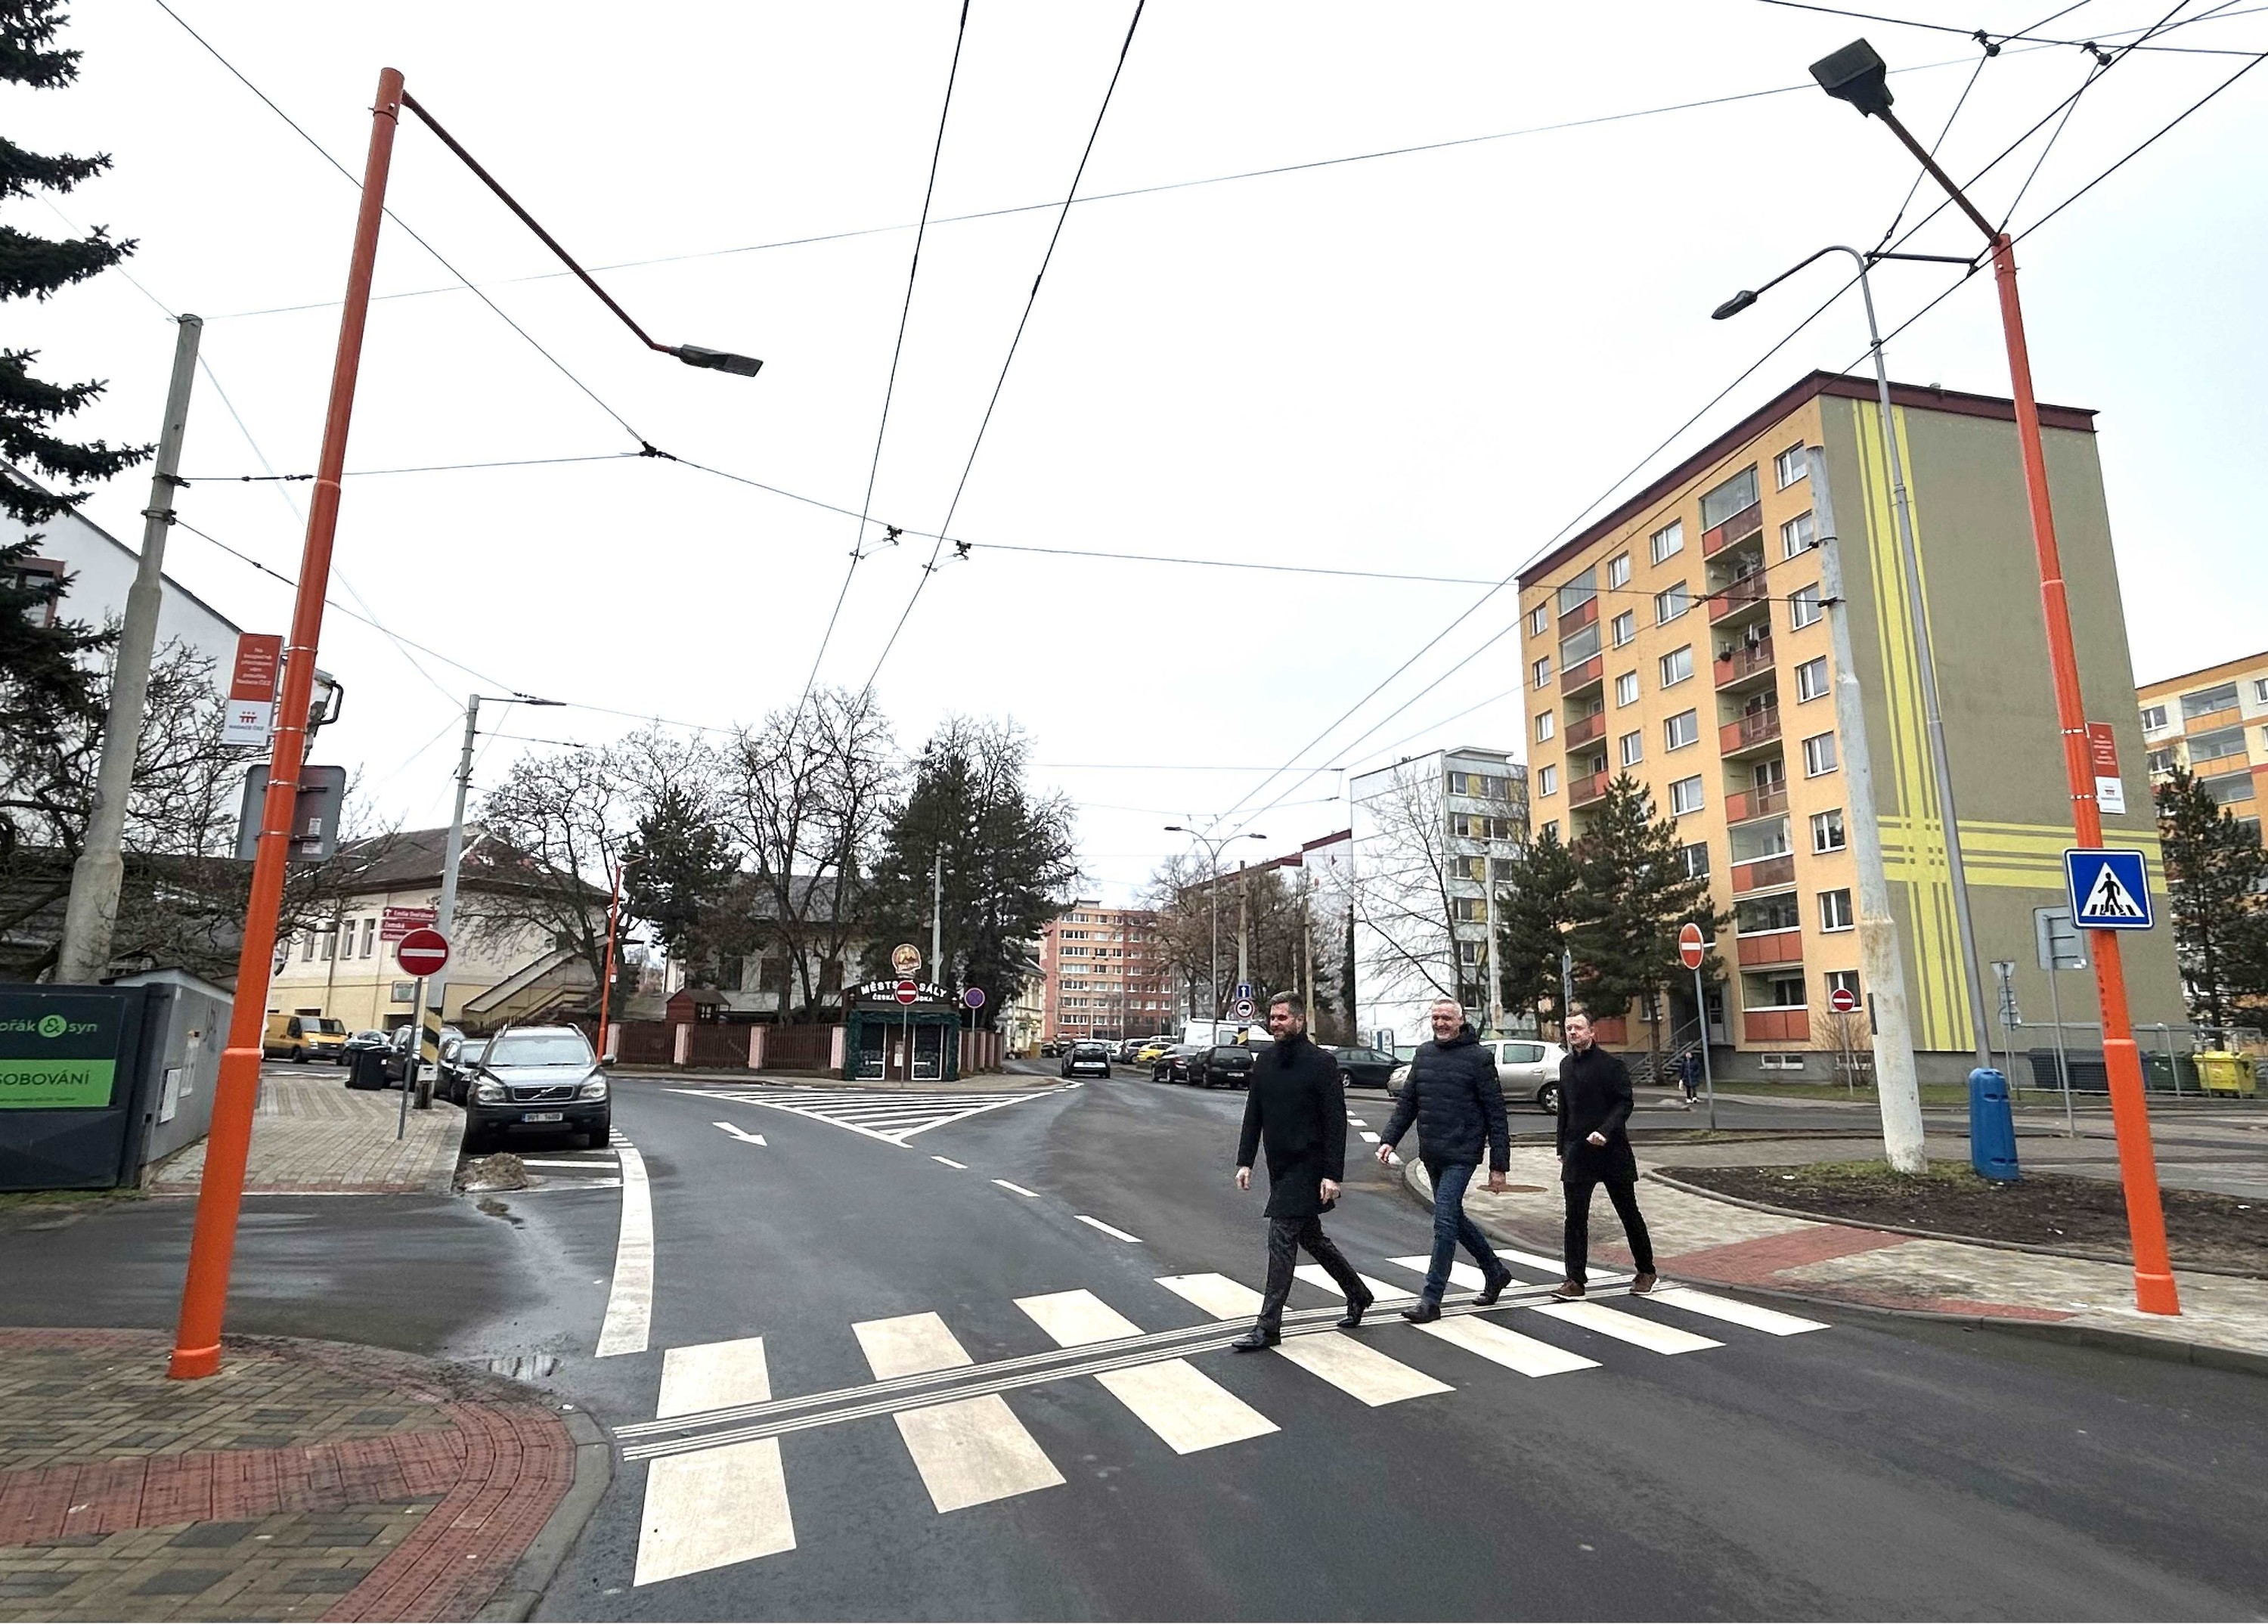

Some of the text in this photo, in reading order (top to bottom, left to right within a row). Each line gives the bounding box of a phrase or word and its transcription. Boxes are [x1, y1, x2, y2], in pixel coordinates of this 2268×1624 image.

[860, 981, 947, 997] MĚSTS SÁLY
[69, 1023, 98, 1034] syn
[0, 1070, 90, 1085] OBOVÁNÍ
